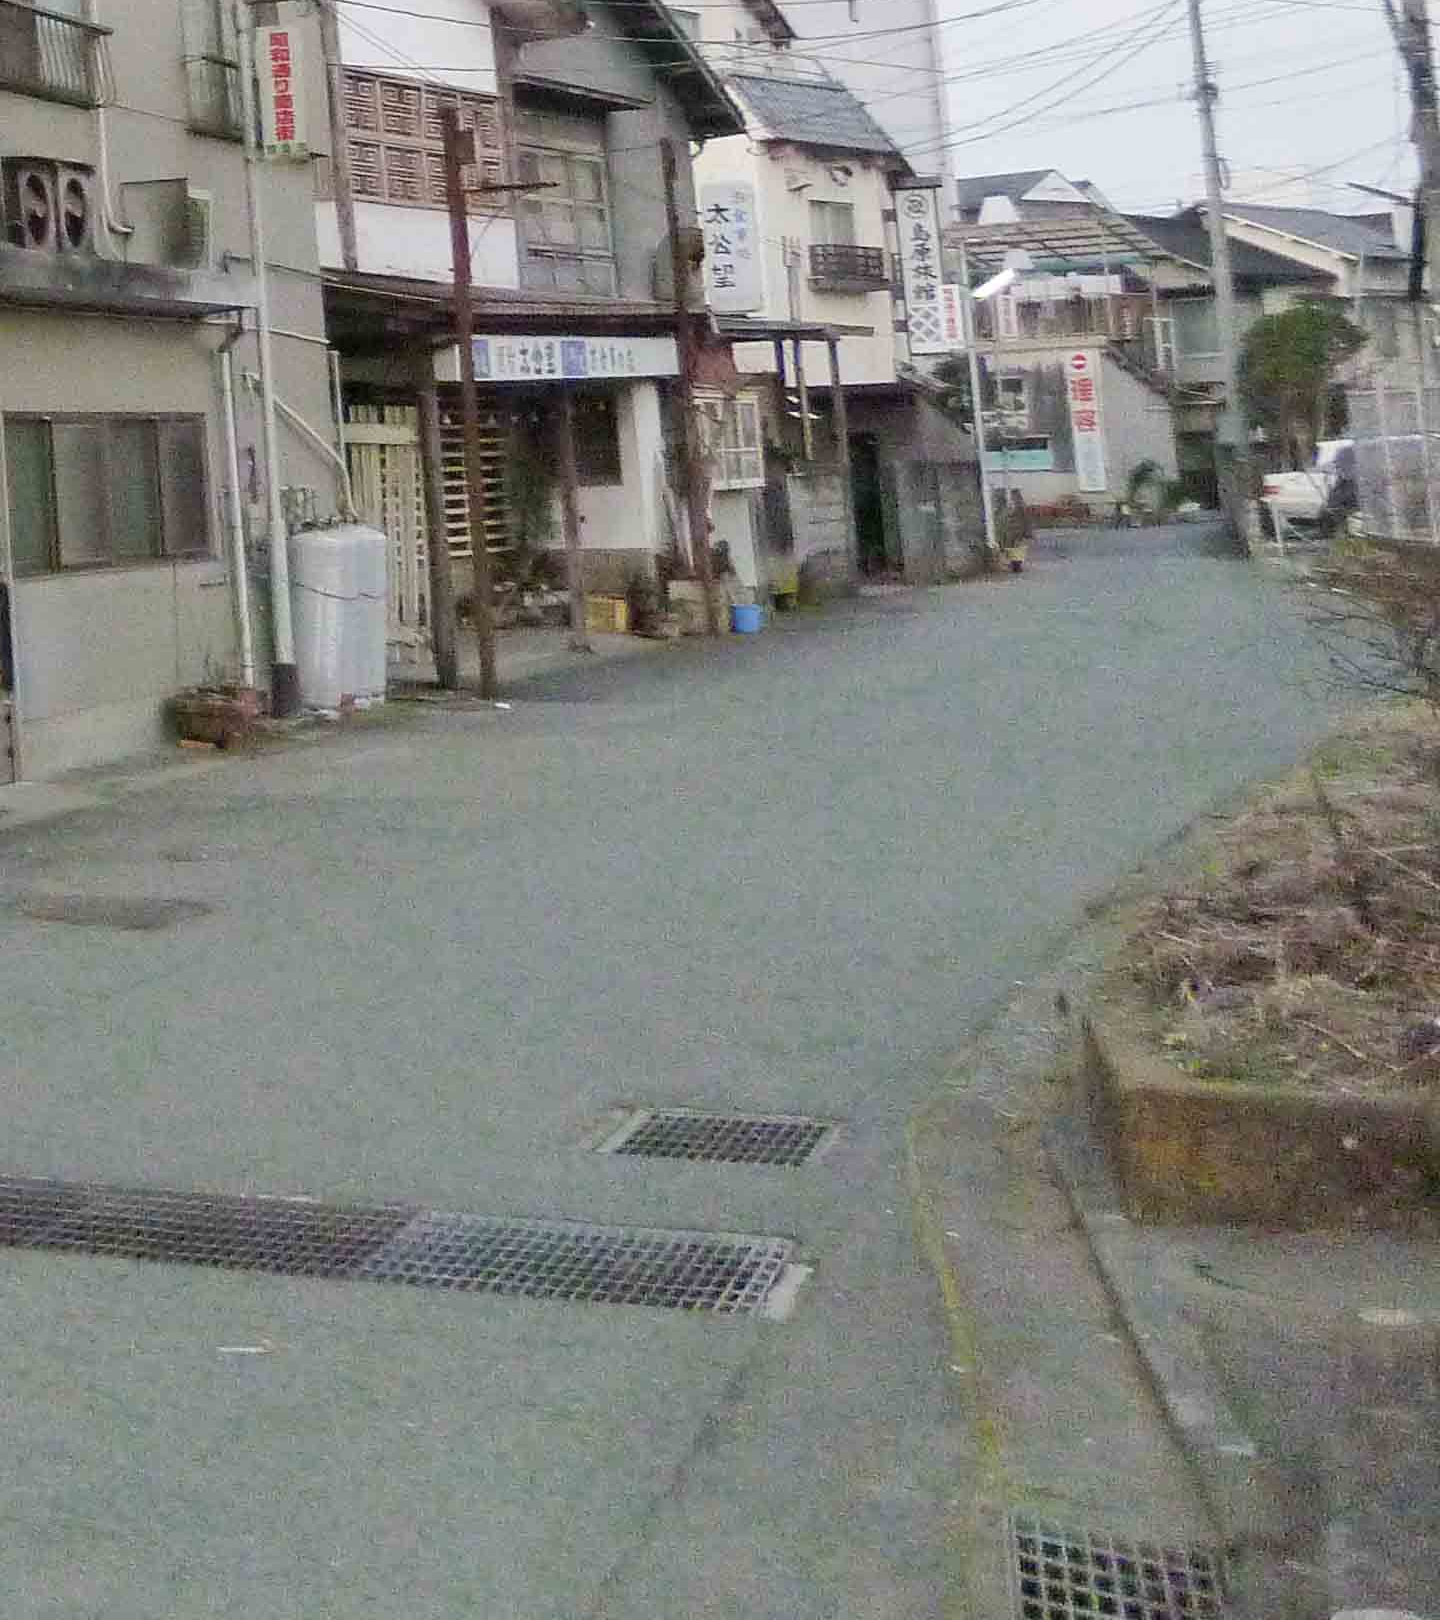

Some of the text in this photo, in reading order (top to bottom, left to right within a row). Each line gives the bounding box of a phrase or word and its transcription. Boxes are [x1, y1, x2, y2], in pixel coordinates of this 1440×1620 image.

[270, 32, 296, 141] 昭和通り商店街
